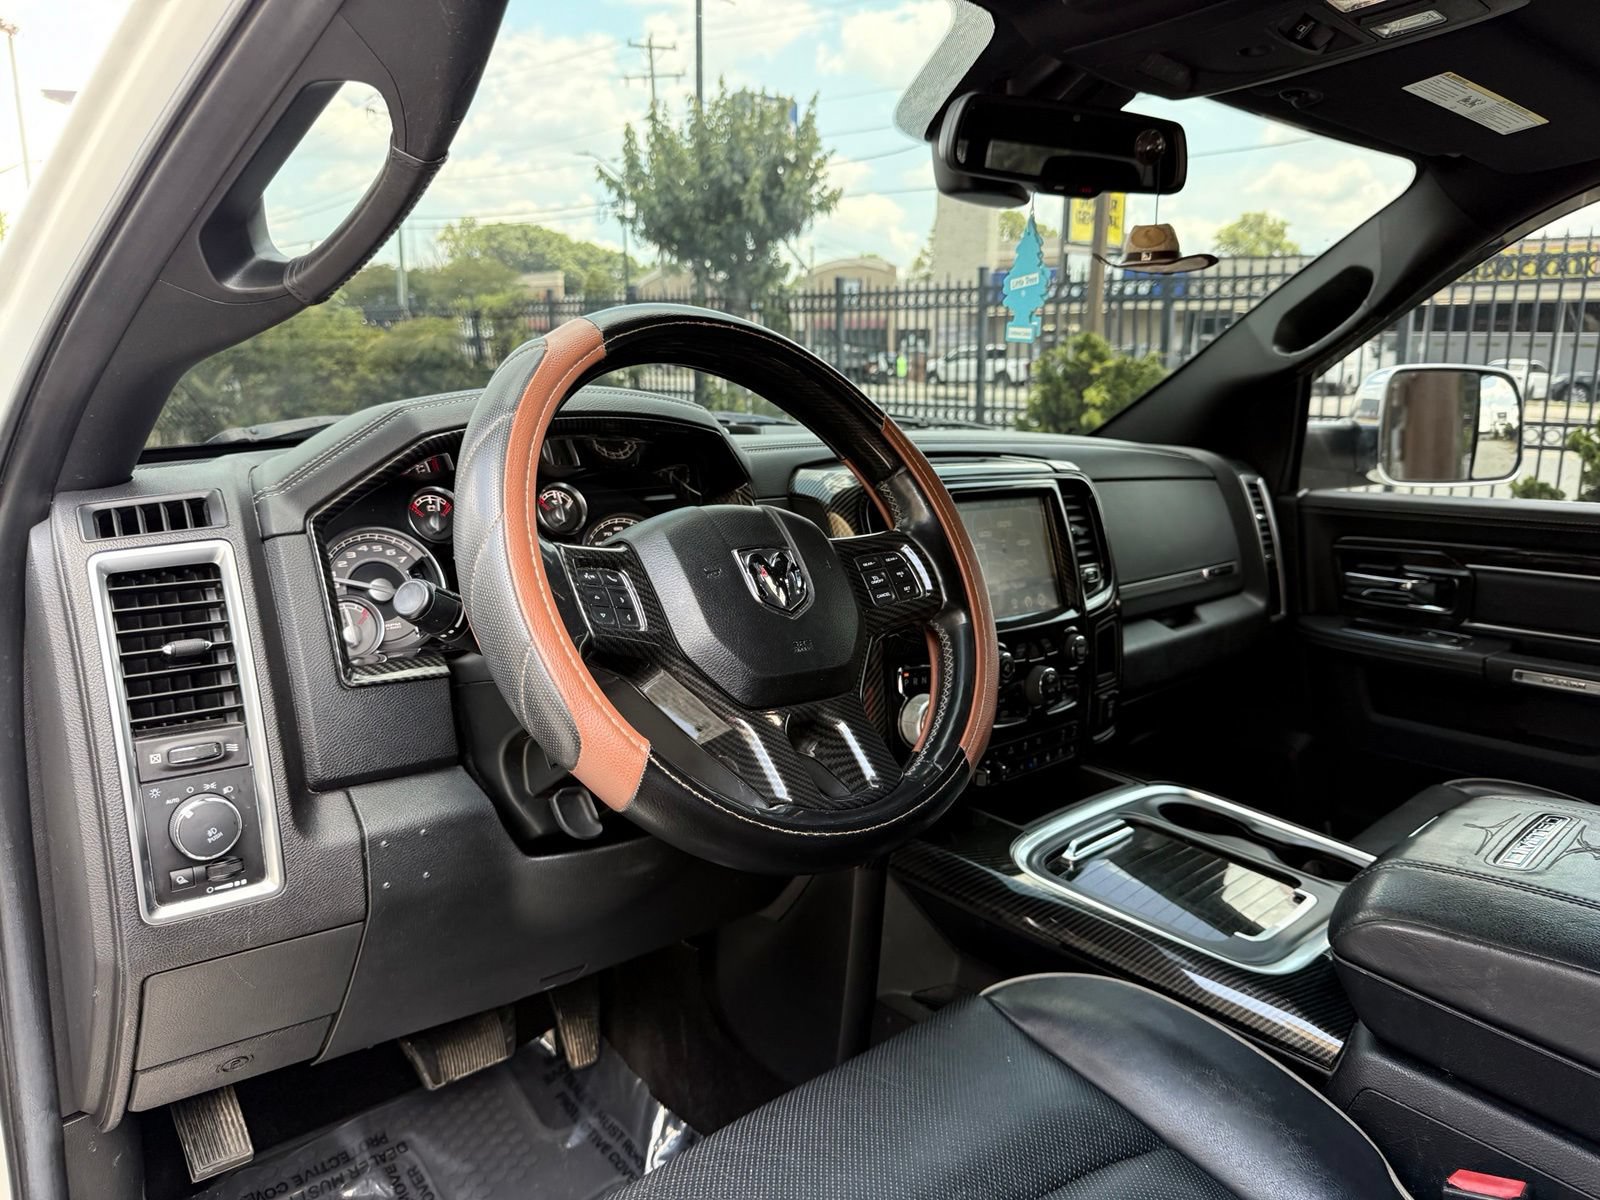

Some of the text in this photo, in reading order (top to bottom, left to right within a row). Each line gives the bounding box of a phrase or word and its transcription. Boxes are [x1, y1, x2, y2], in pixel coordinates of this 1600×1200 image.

[337, 560, 348, 568] 2
[165, 797, 180, 805] AUTO
[1502, 817, 1563, 866] LIMITED
[347, 1141, 409, 1180] DEALER
